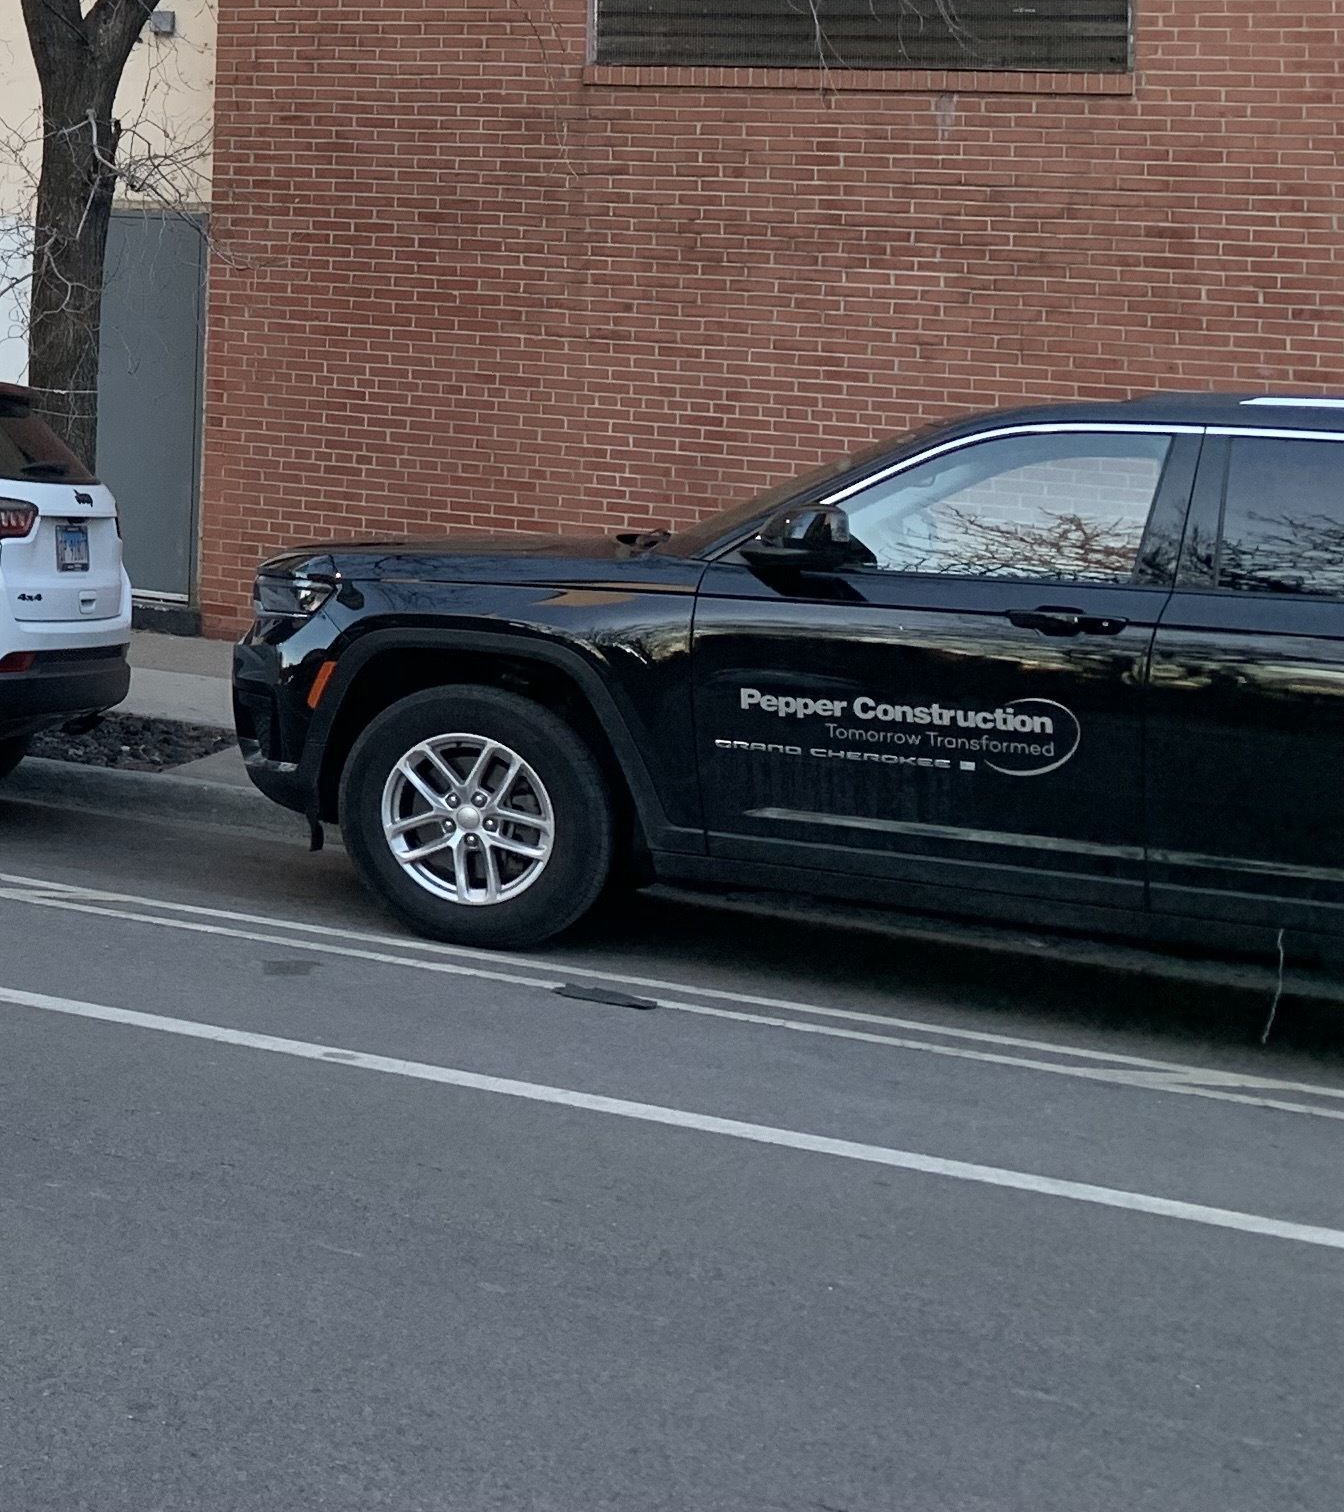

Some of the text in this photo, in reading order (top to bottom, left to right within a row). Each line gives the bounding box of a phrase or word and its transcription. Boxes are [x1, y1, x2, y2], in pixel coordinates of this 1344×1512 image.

[17, 593, 43, 602] 4x4
[739, 687, 1054, 734] Pepper Construction
[714, 739, 951, 769] GRAND CHEROKEE
[824, 722, 1055, 757] Tomorrow Transformed
